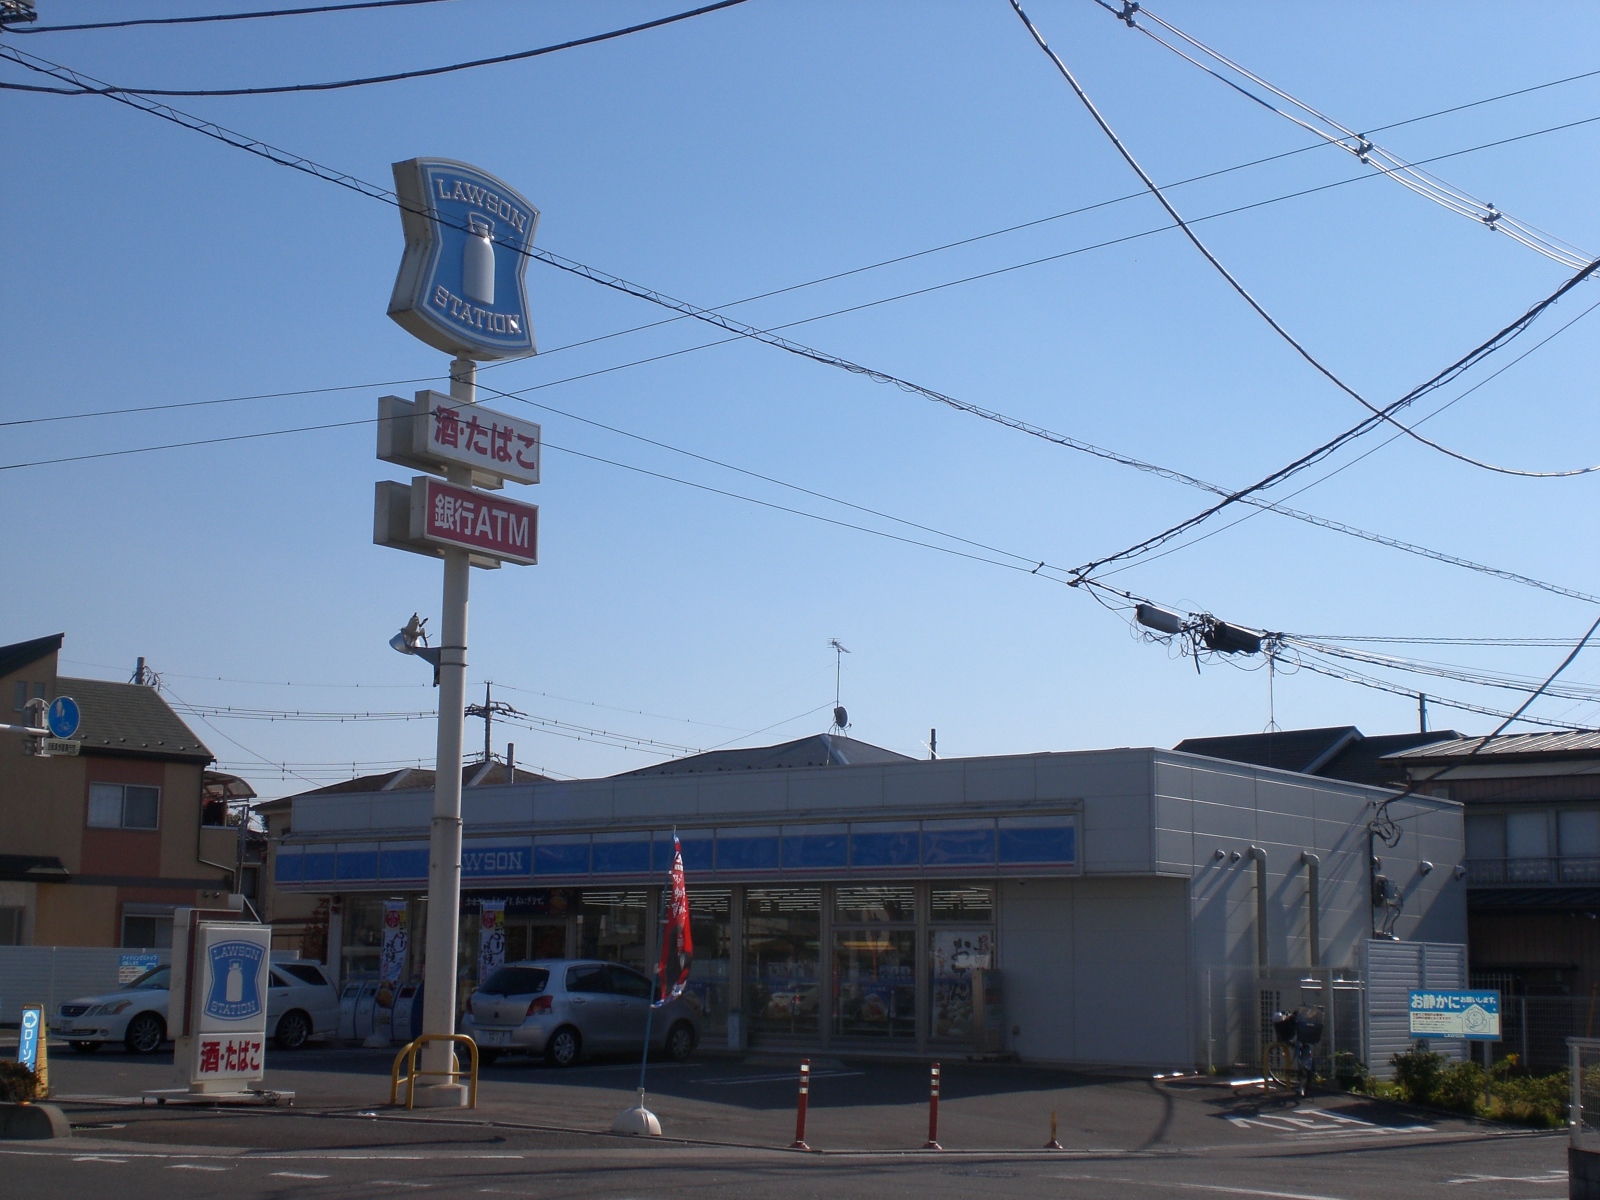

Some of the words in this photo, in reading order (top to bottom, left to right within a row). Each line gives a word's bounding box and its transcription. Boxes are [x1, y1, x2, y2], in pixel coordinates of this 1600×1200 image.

[436, 178, 527, 234] LAWSON
[434, 284, 522, 335] STATION
[434, 492, 530, 550] 銀行ATM
[212, 946, 261, 961] LAWSON
[210, 1000, 257, 1014] STATION
[1411, 993, 1460, 1009] お静かに
